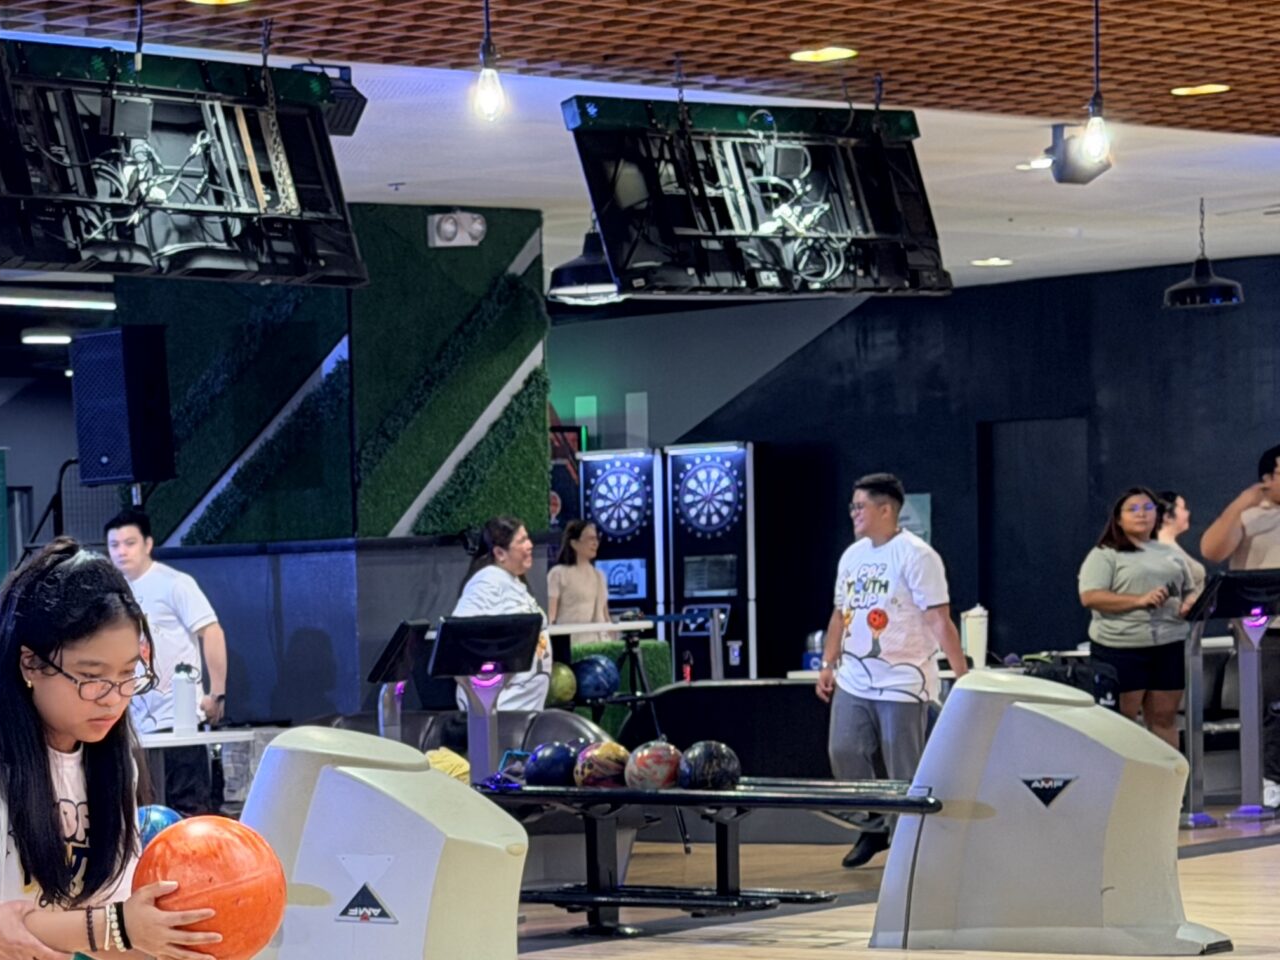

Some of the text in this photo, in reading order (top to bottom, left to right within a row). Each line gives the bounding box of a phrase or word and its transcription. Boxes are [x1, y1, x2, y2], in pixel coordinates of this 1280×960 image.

[850, 593, 879, 609] CUP
[1031, 780, 1064, 789] AMF
[347, 907, 382, 917] AMF
